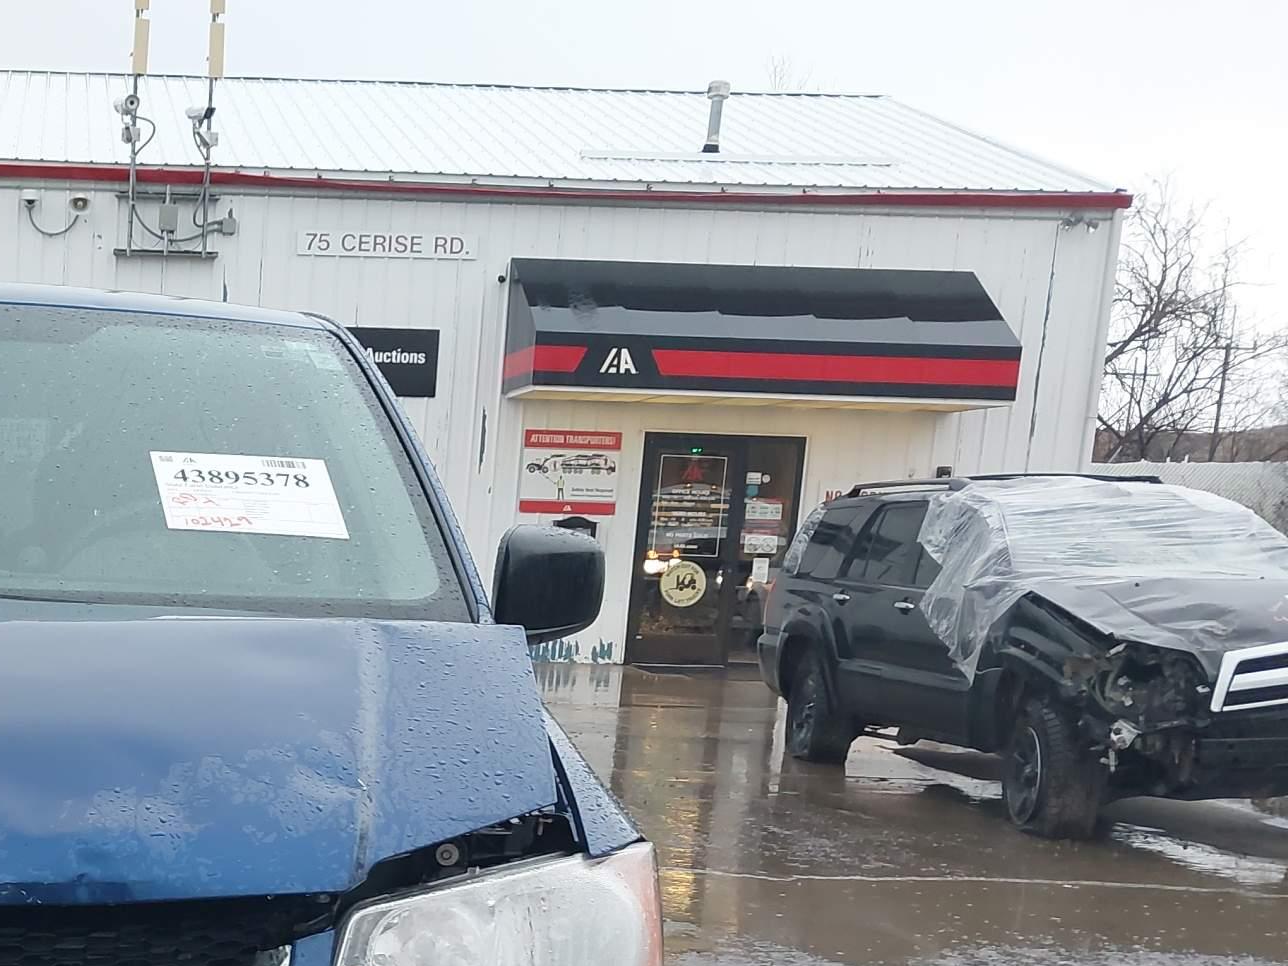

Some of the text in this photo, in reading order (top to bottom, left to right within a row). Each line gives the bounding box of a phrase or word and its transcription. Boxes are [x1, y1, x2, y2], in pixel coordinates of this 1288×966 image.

[305, 232, 470, 255] 75 CERISE RD.
[364, 348, 426, 364] Auctions
[530, 434, 565, 443] ATTENTION
[173, 468, 310, 488] 43895378
